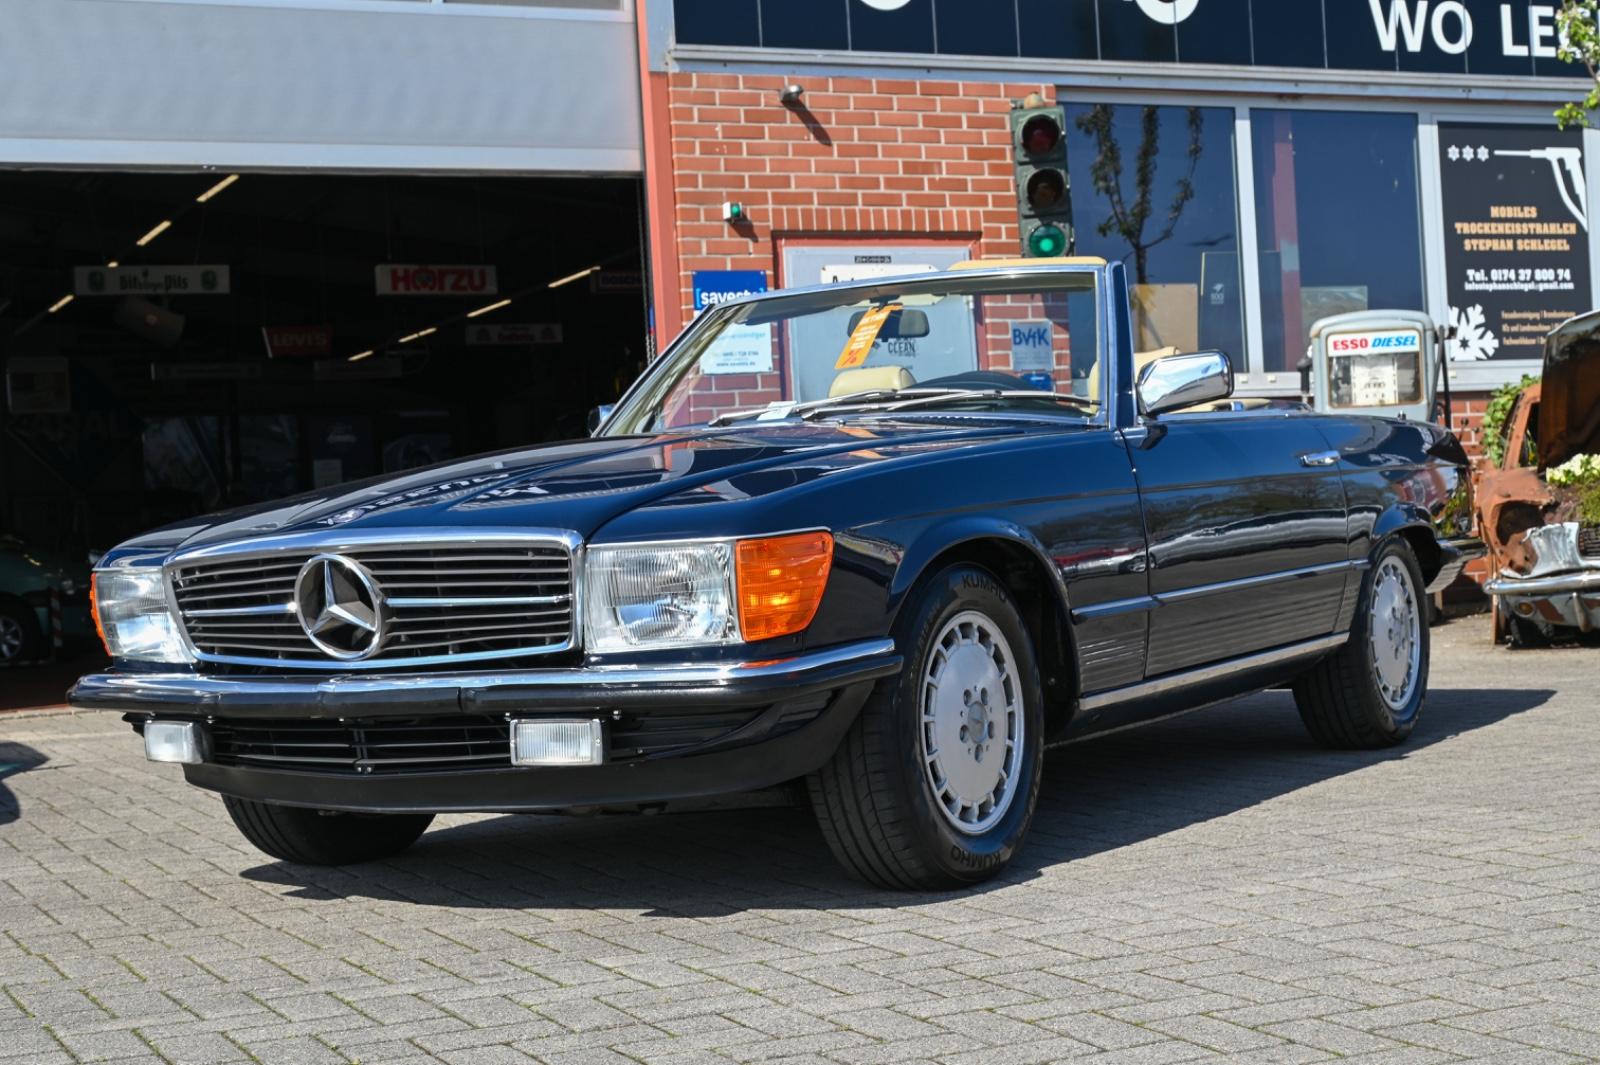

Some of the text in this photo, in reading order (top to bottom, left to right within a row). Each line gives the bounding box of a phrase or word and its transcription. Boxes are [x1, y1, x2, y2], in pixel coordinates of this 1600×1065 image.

[1369, 0, 1600, 59] WO LE
[1490, 206, 1537, 218] MOBILES
[1455, 222, 1577, 234] TROCKENEISSTRAHLEN
[1464, 239, 1570, 251] STEPHAN SCHLEGEL
[1466, 269, 1488, 281] Tel.
[1490, 269, 1516, 281] 0174
[1518, 269, 1532, 281] 37
[1556, 269, 1571, 281] 74
[1333, 335, 1417, 351] ESSO DIESEL
[961, 574, 1007, 603] KUMHO
[951, 845, 1001, 869] KUMHO
